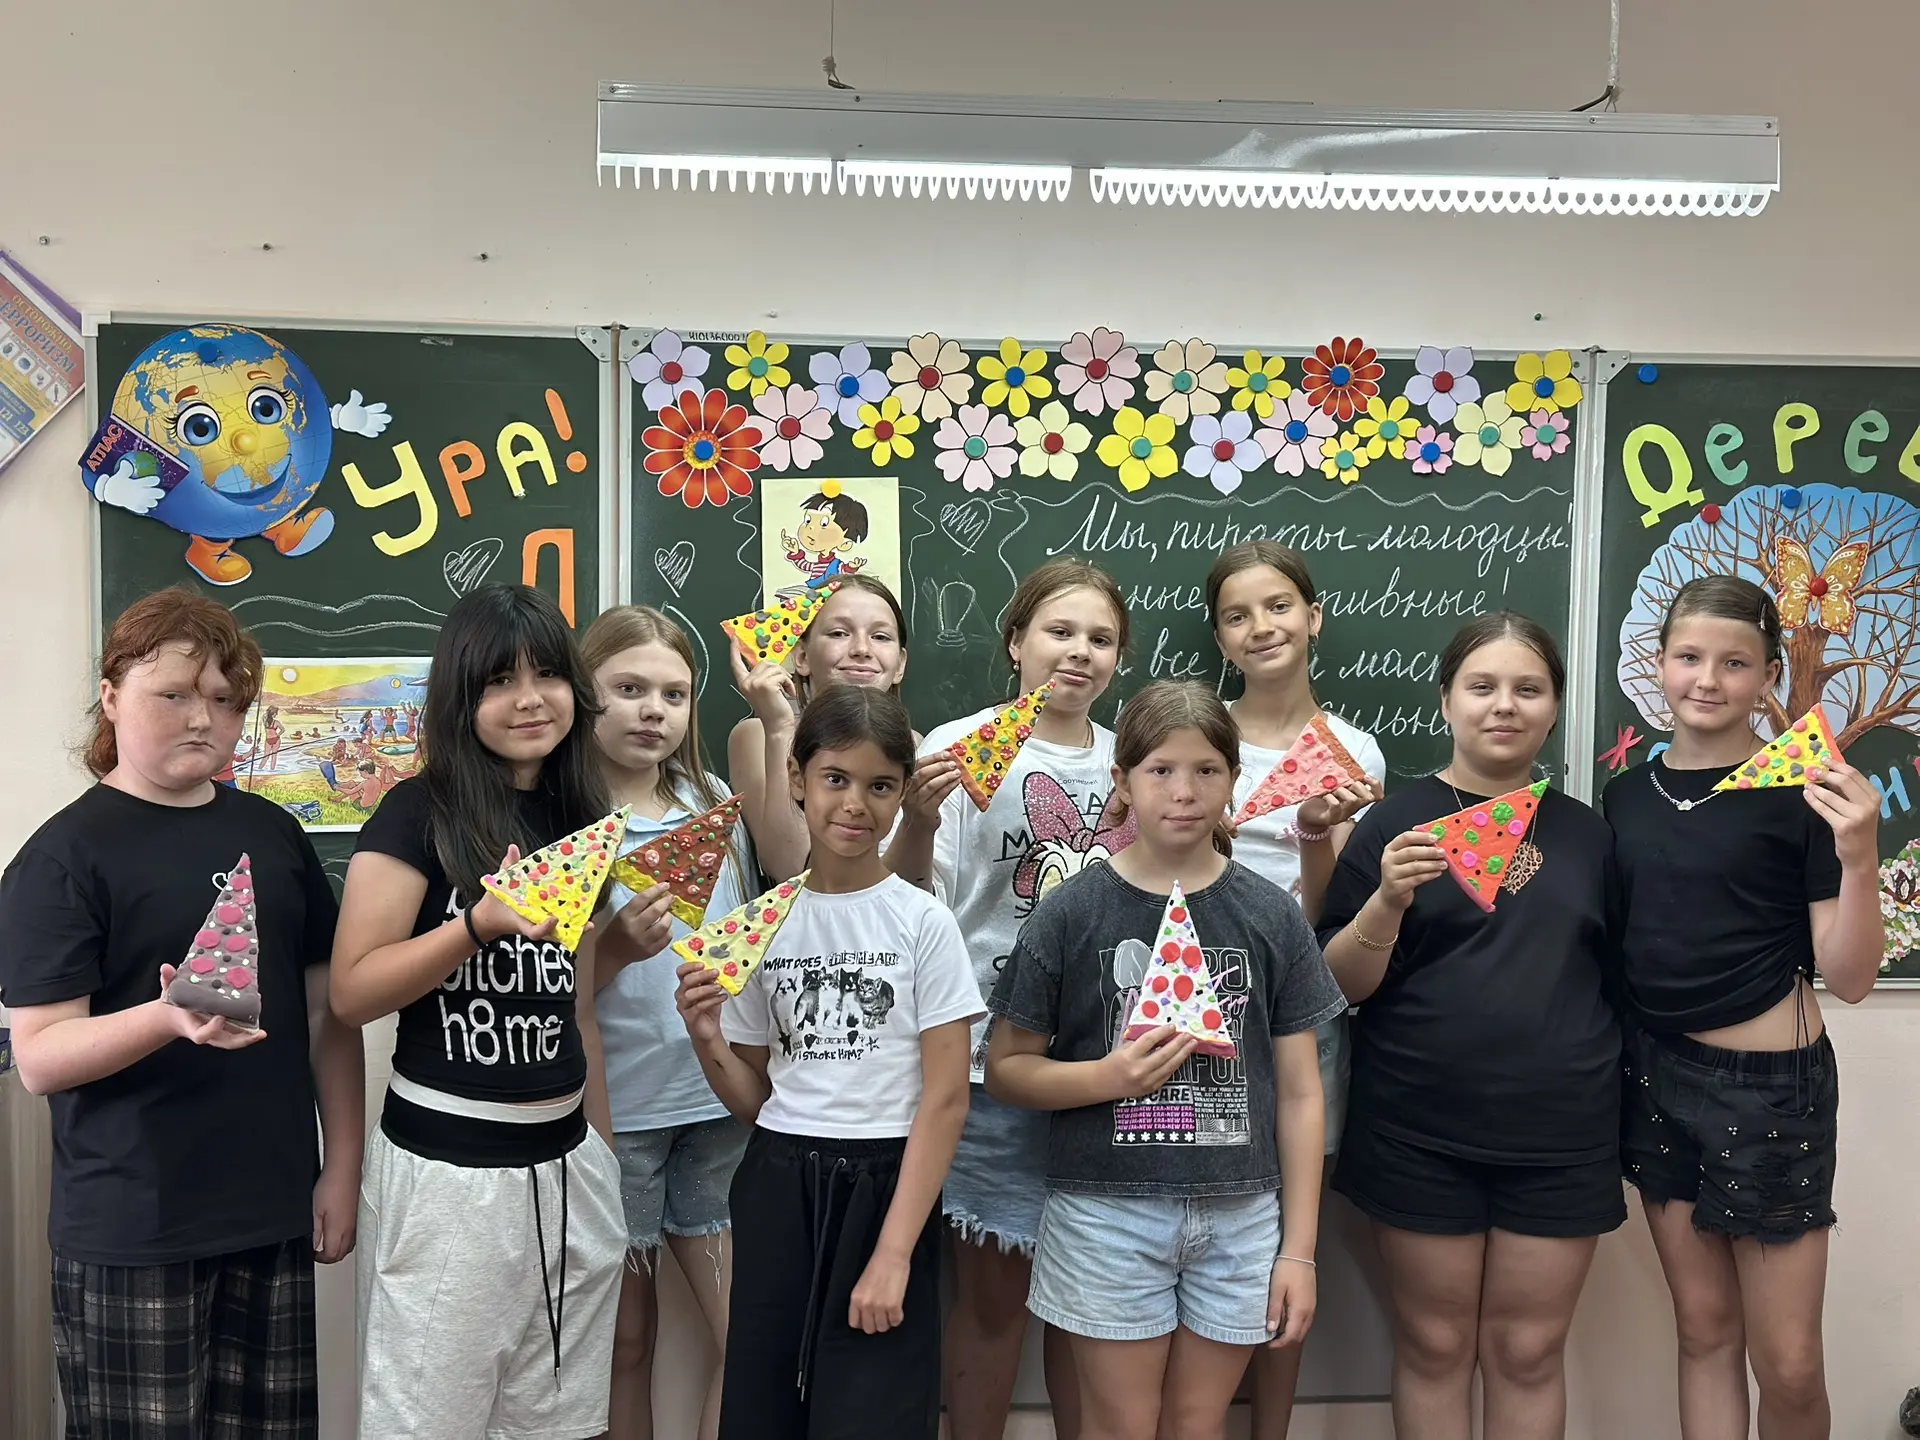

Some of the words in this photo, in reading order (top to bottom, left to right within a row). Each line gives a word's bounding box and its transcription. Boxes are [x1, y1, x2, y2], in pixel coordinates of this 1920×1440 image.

[0, 300, 76, 374] ЕРРОРИЗМ
[87, 424, 123, 472] АТЛАС
[341, 388, 587, 555] УРА!
[1046, 494, 1158, 563] Мы,
[1117, 585, 1209, 622] ные,
[1149, 627, 1208, 677] все
[764, 957, 793, 971] WHAT
[794, 956, 822, 968] DOES
[505, 1014, 563, 1064] me
[803, 1050, 836, 1061] STROKE
